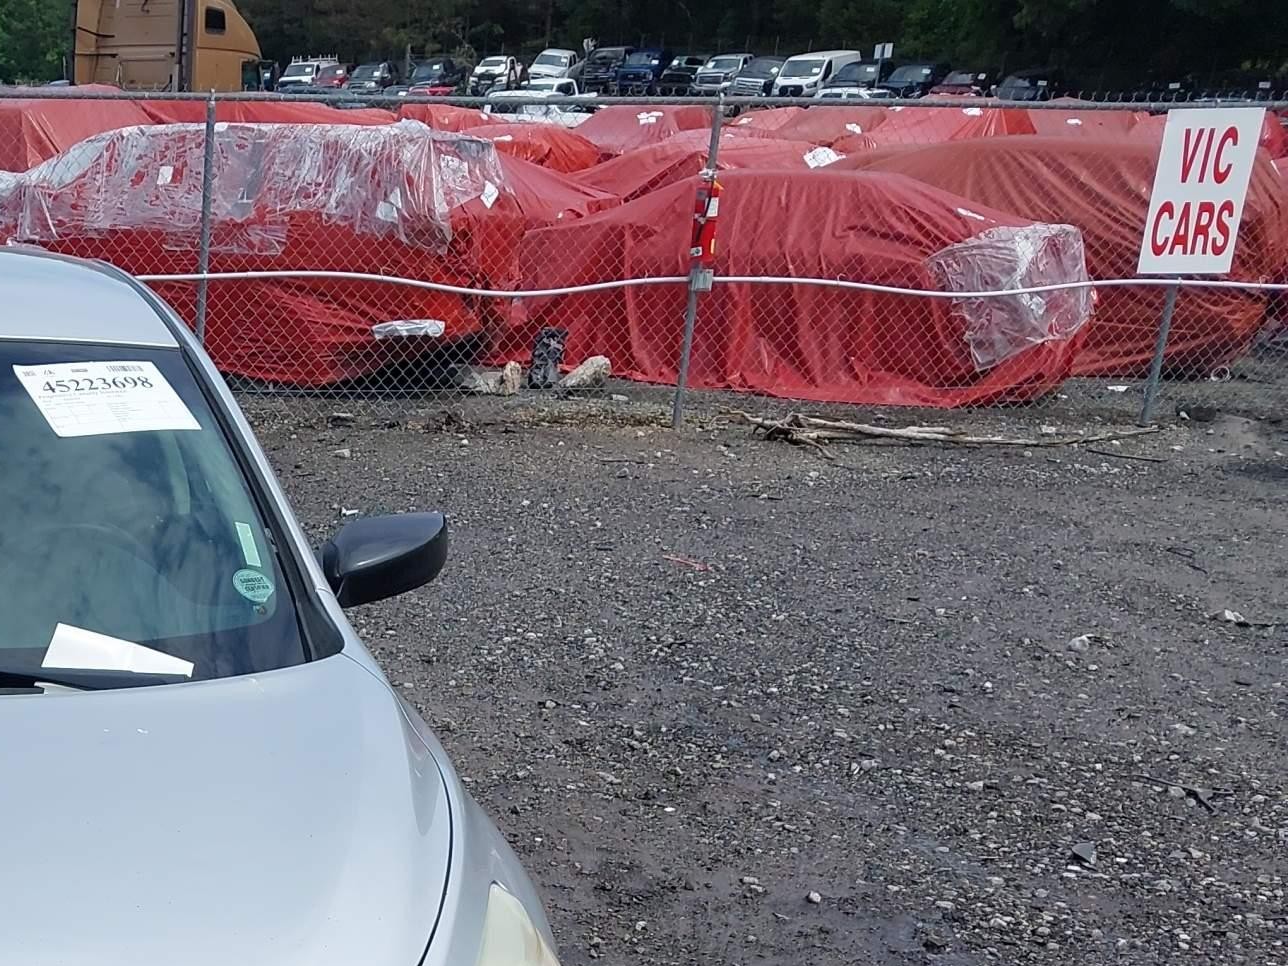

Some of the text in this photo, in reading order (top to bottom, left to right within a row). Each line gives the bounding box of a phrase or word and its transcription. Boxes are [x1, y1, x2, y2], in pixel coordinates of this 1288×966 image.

[1180, 126, 1239, 185] VIC
[1150, 200, 1235, 256] CARS
[42, 375, 154, 393] 45223698
